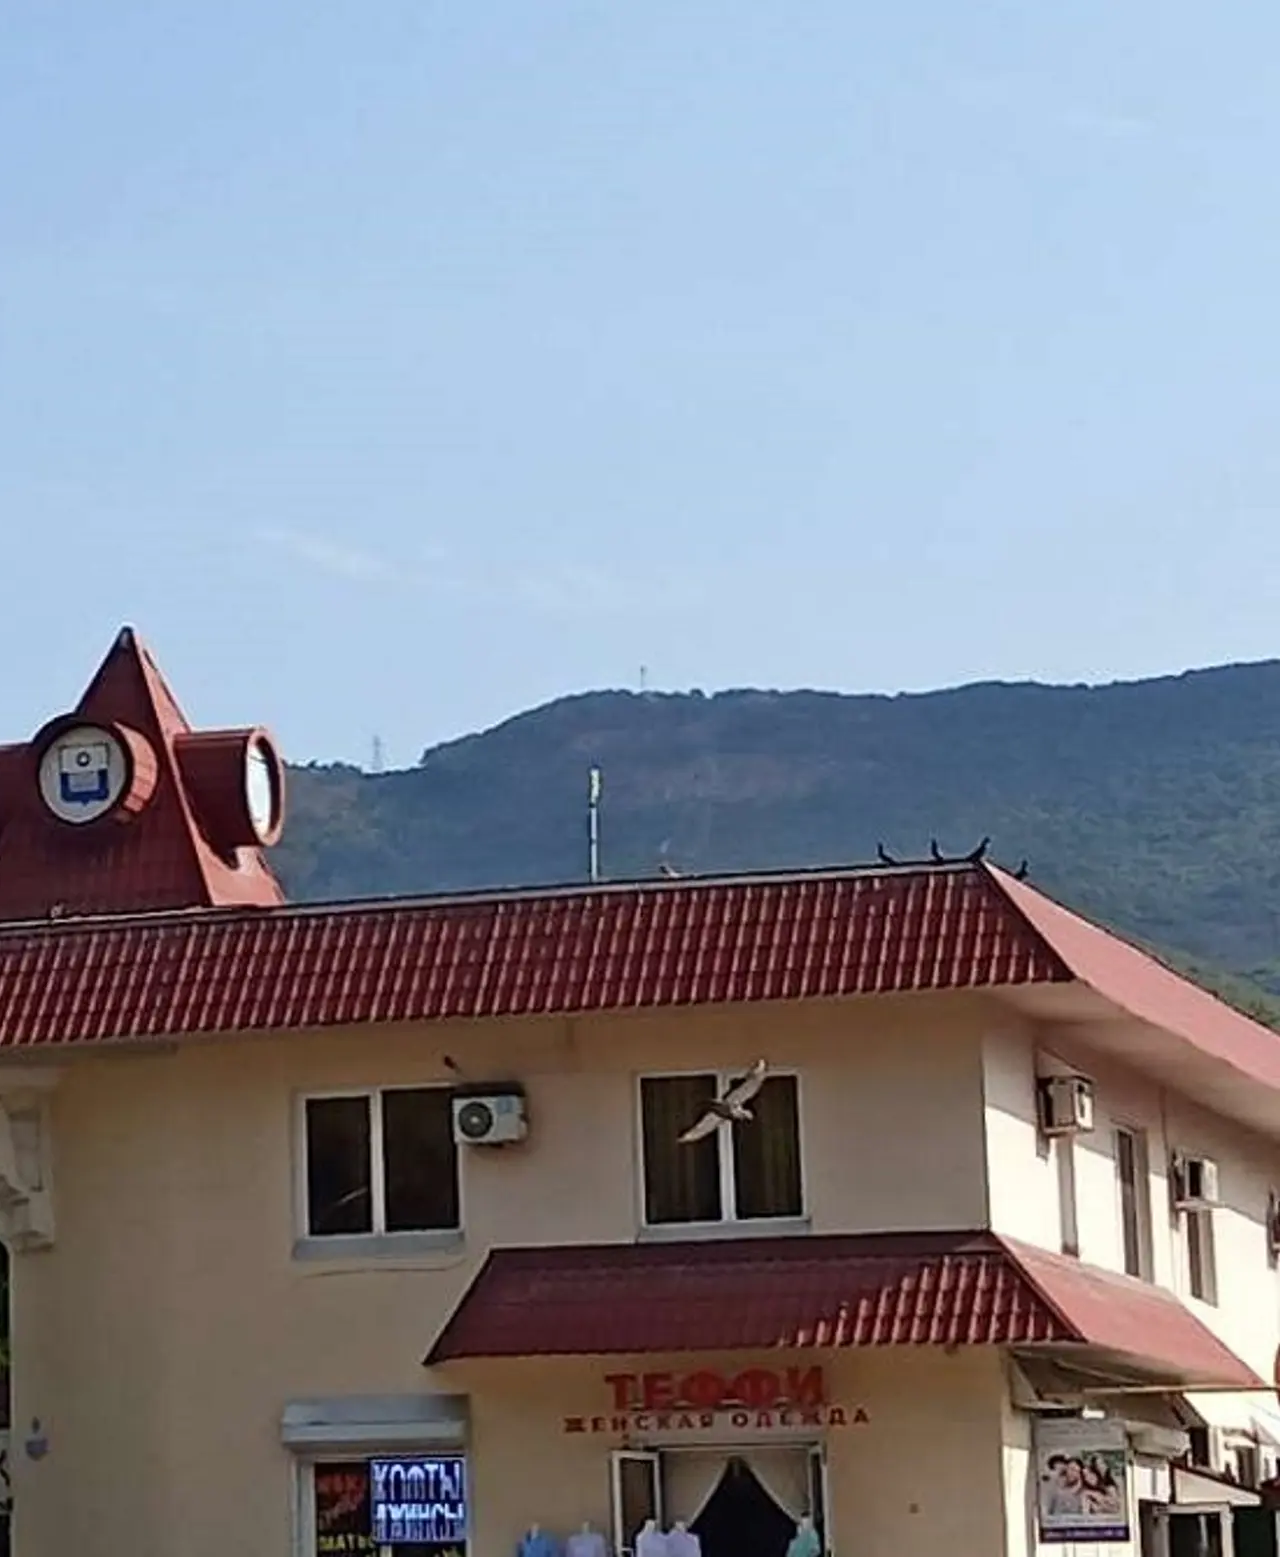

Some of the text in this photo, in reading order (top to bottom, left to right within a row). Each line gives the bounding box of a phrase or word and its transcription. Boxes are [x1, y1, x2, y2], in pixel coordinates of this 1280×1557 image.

[605, 1365, 826, 1411] ТЕФФИ
[564, 1407, 869, 1433] ЖЕНСКАЯ ОДЕЖДА
